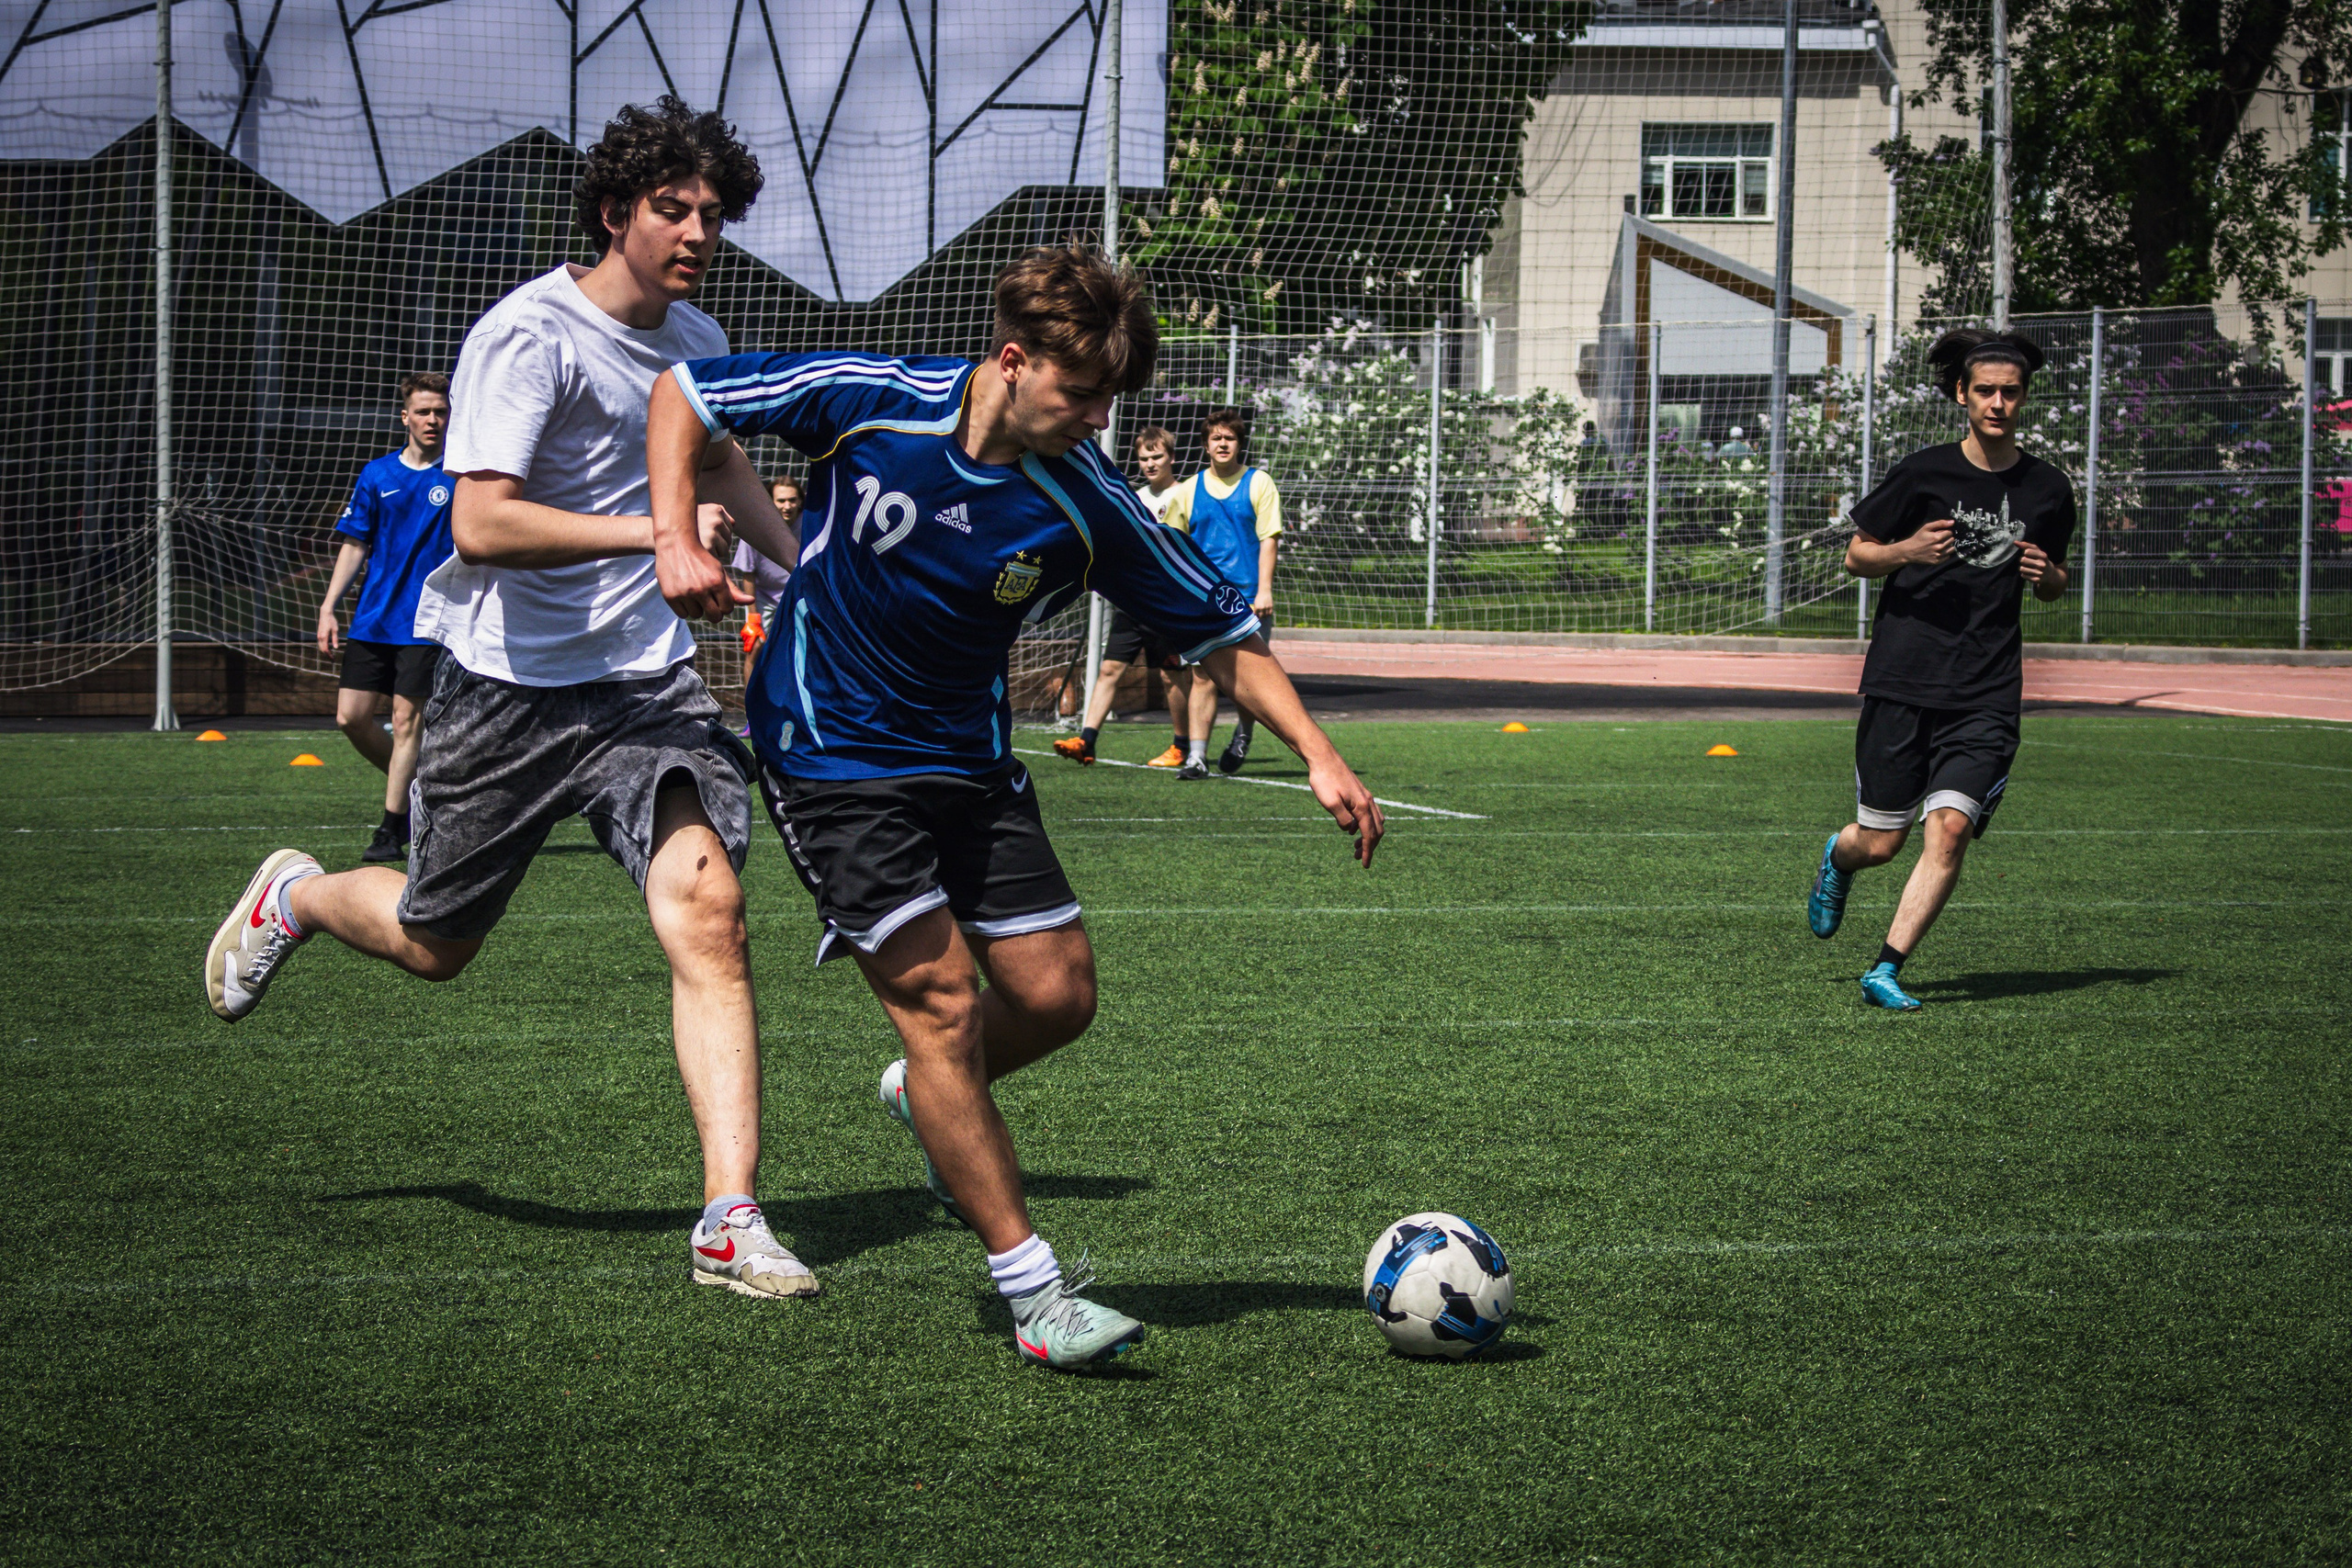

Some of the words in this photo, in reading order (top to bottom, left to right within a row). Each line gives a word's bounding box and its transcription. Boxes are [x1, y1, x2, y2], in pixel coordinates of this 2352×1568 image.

[852, 475, 917, 555] 19
[934, 513, 972, 534] adidas
[1004, 574, 1028, 593] AFA
